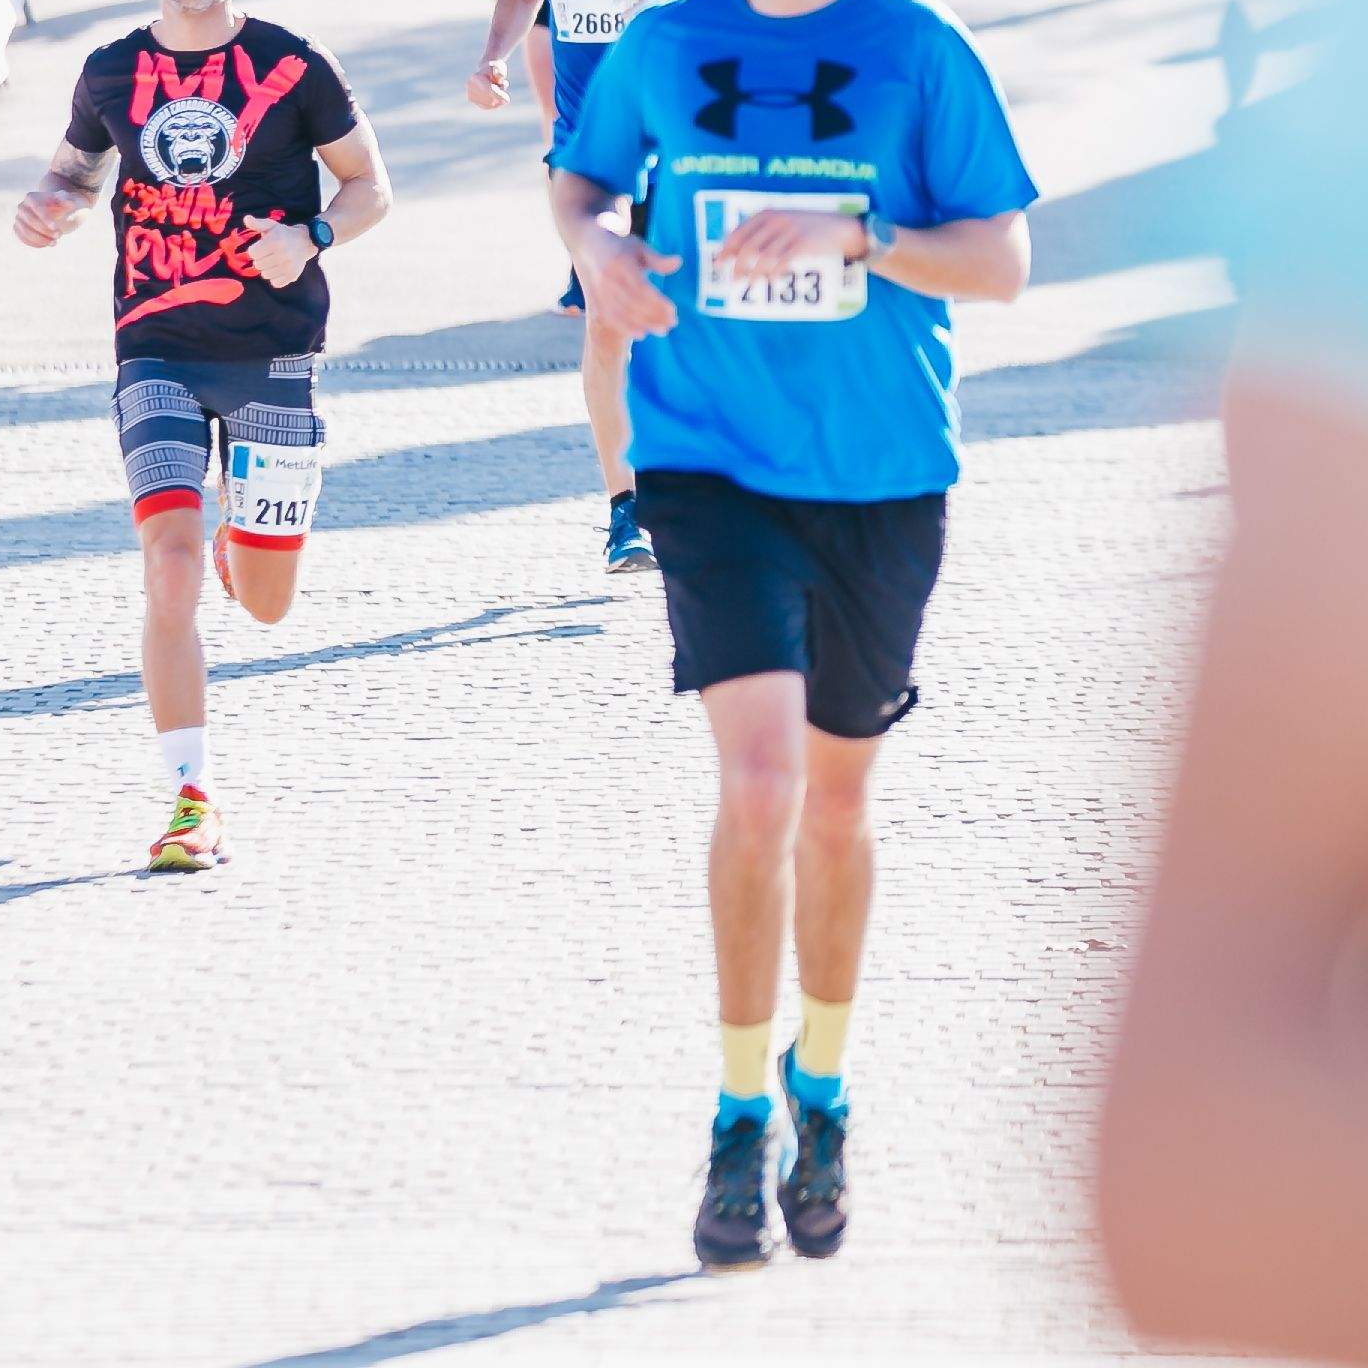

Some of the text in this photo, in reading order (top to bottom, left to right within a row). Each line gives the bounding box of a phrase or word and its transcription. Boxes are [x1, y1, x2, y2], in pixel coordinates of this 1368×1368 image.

[572, 12, 625, 34] 2668
[129, 44, 307, 149] MY
[125, 209, 285, 297] RULE
[741, 270, 820, 305] 2133
[255, 498, 309, 526] 2147
